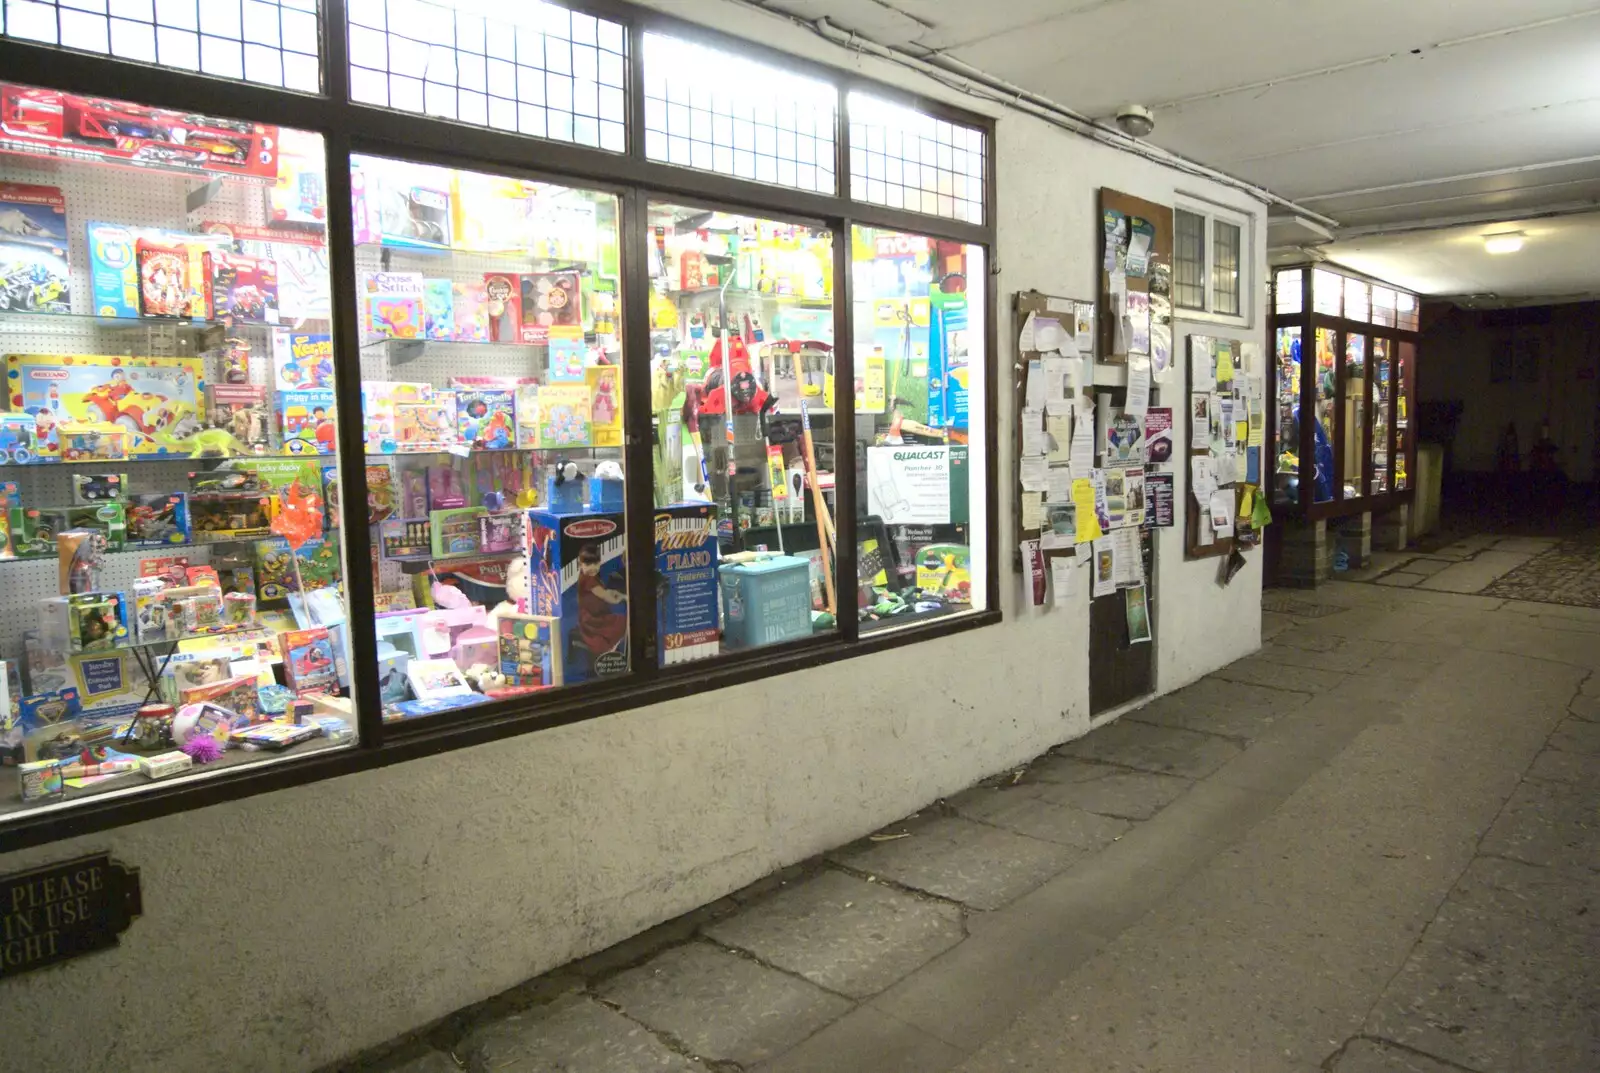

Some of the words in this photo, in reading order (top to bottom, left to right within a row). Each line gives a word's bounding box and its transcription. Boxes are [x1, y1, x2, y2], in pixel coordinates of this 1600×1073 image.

[375, 271, 413, 284] Cross
[286, 394, 309, 403] piggy
[310, 392, 319, 401] in
[893, 451, 946, 462] QUALCAST
[904, 464, 932, 472] Panther
[666, 550, 711, 571] PIANO
[665, 632, 684, 649] 30
[12, 866, 103, 913] PLEASE
[44, 896, 91, 928] USE
